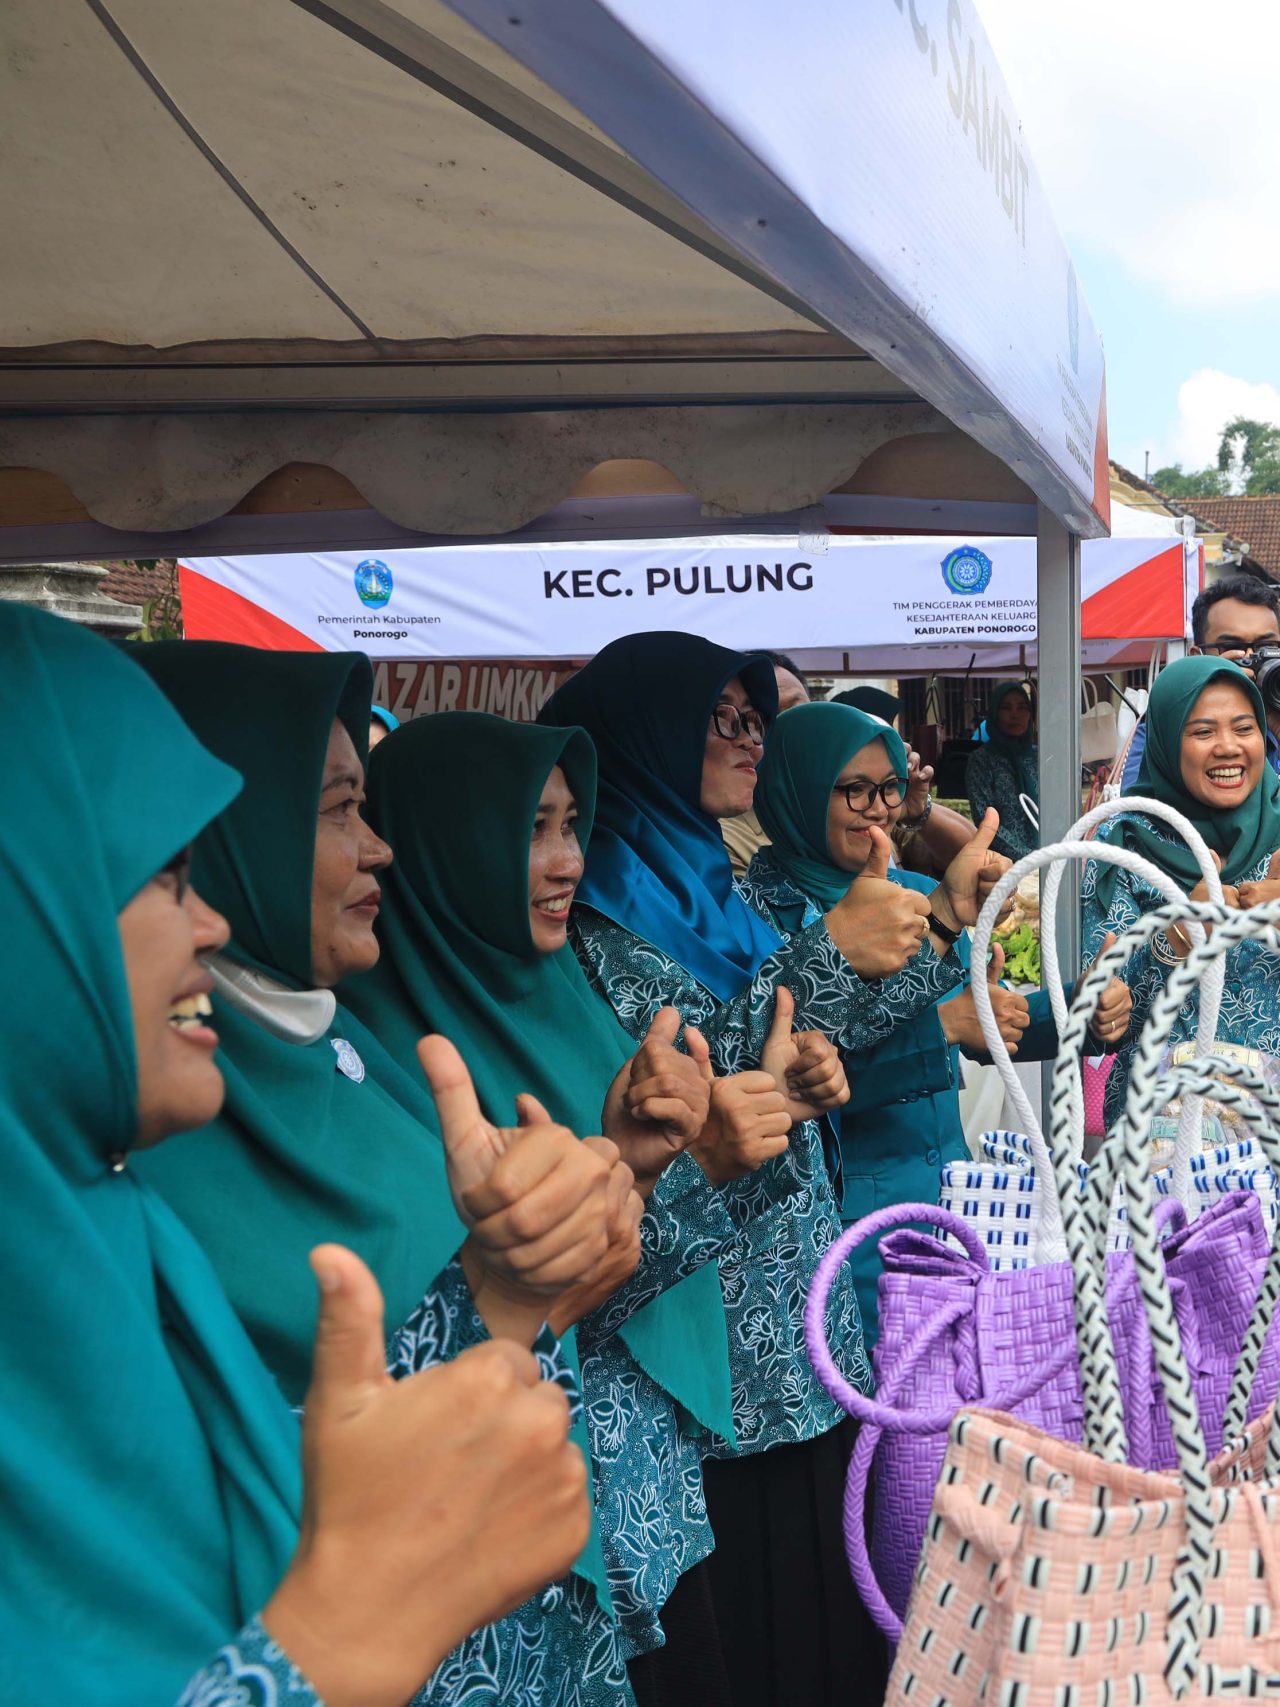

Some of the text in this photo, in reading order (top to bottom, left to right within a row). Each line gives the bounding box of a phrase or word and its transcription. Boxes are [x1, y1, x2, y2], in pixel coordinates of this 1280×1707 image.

[894, 0, 1029, 248] C. SAMBIT
[543, 562, 814, 598] KEC. PULUNG
[893, 599, 1038, 610] TIM PENGGERAK PEMBERDAY
[318, 615, 441, 626] Pemerintah Kabupaten
[907, 611, 1037, 623] KESEJAHTERAAN KELUARG
[353, 629, 408, 640] Ponorogo
[914, 624, 1036, 636] KABUPATEN PONOROGO
[371, 662, 557, 724] AZAR UMKM
